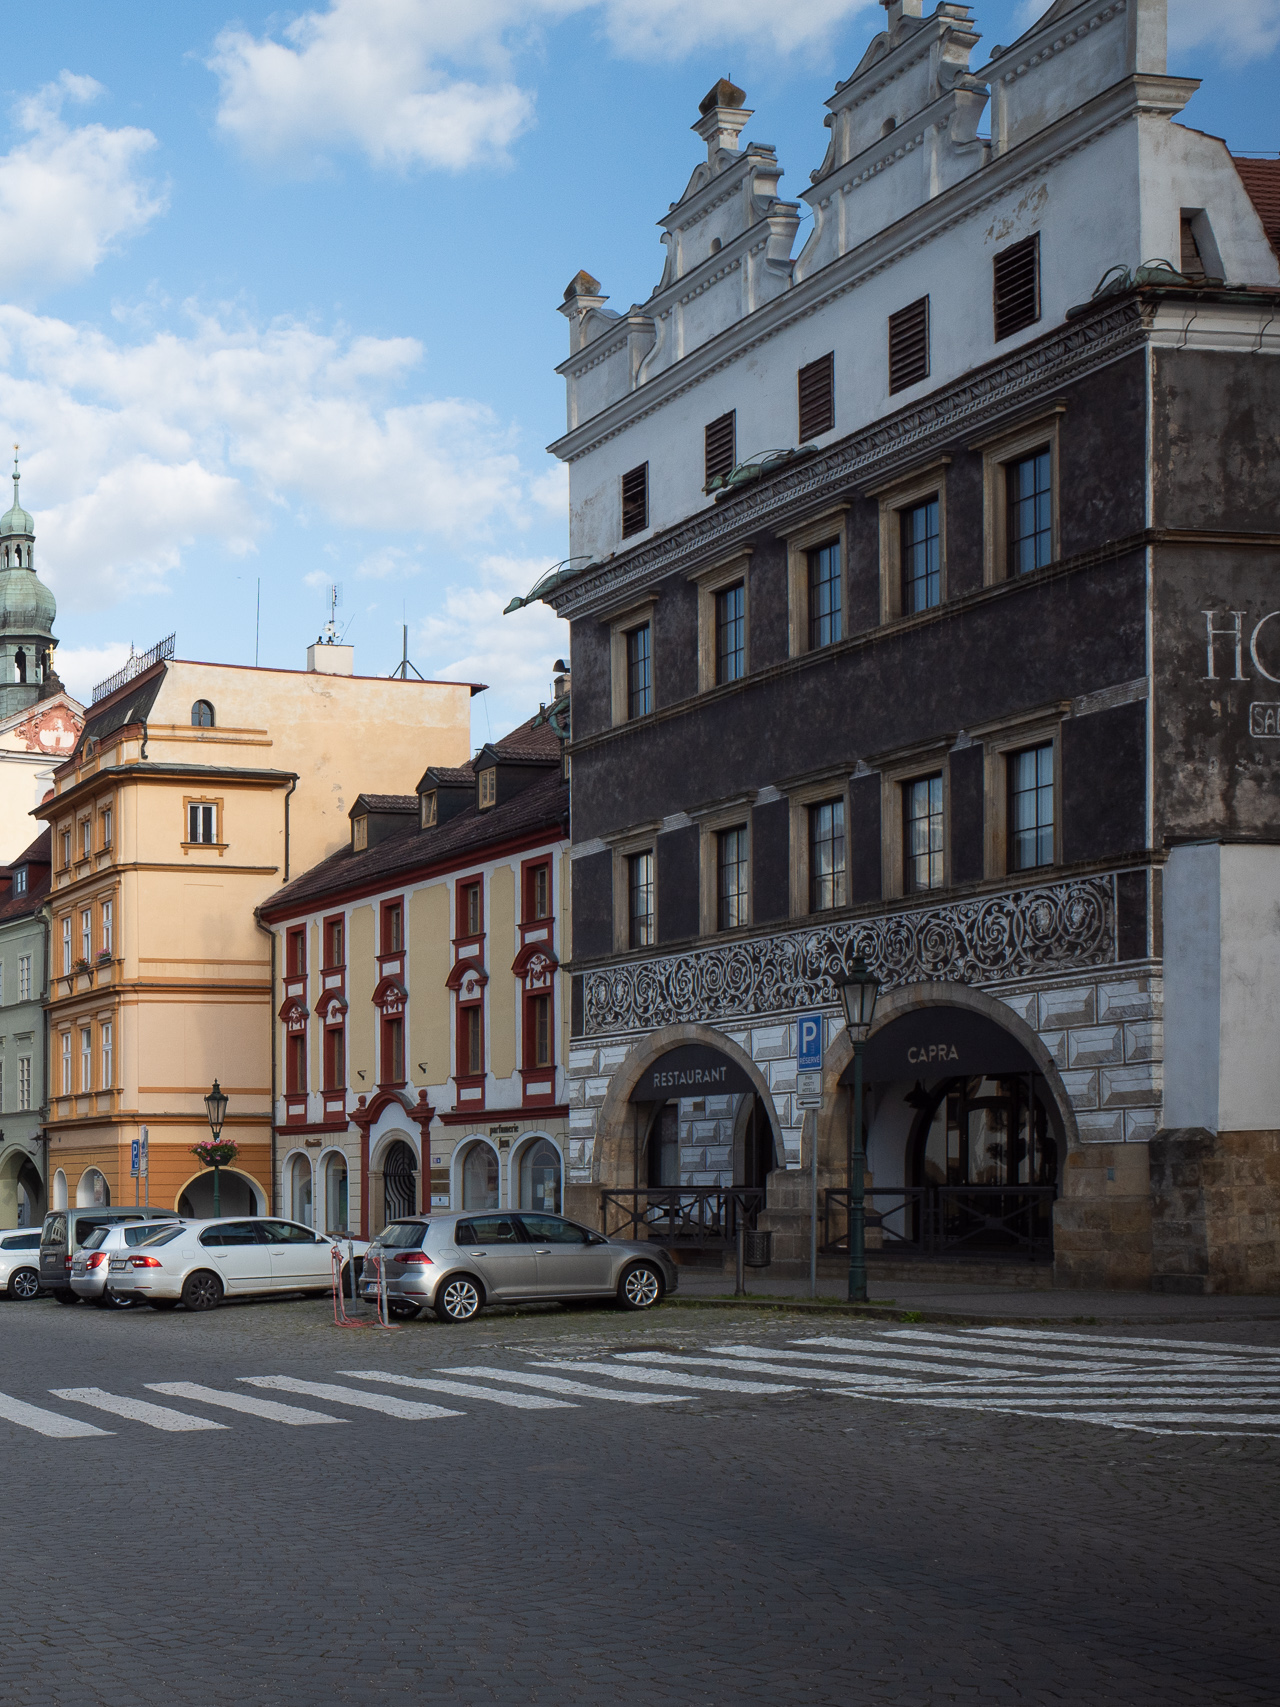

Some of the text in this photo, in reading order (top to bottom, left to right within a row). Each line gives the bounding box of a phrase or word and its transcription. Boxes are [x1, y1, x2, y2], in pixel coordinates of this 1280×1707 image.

[1254, 707, 1280, 734] SA
[802, 1021, 817, 1054] P
[907, 1043, 960, 1064] CAPRA
[653, 1066, 727, 1088] RESTAURANT
